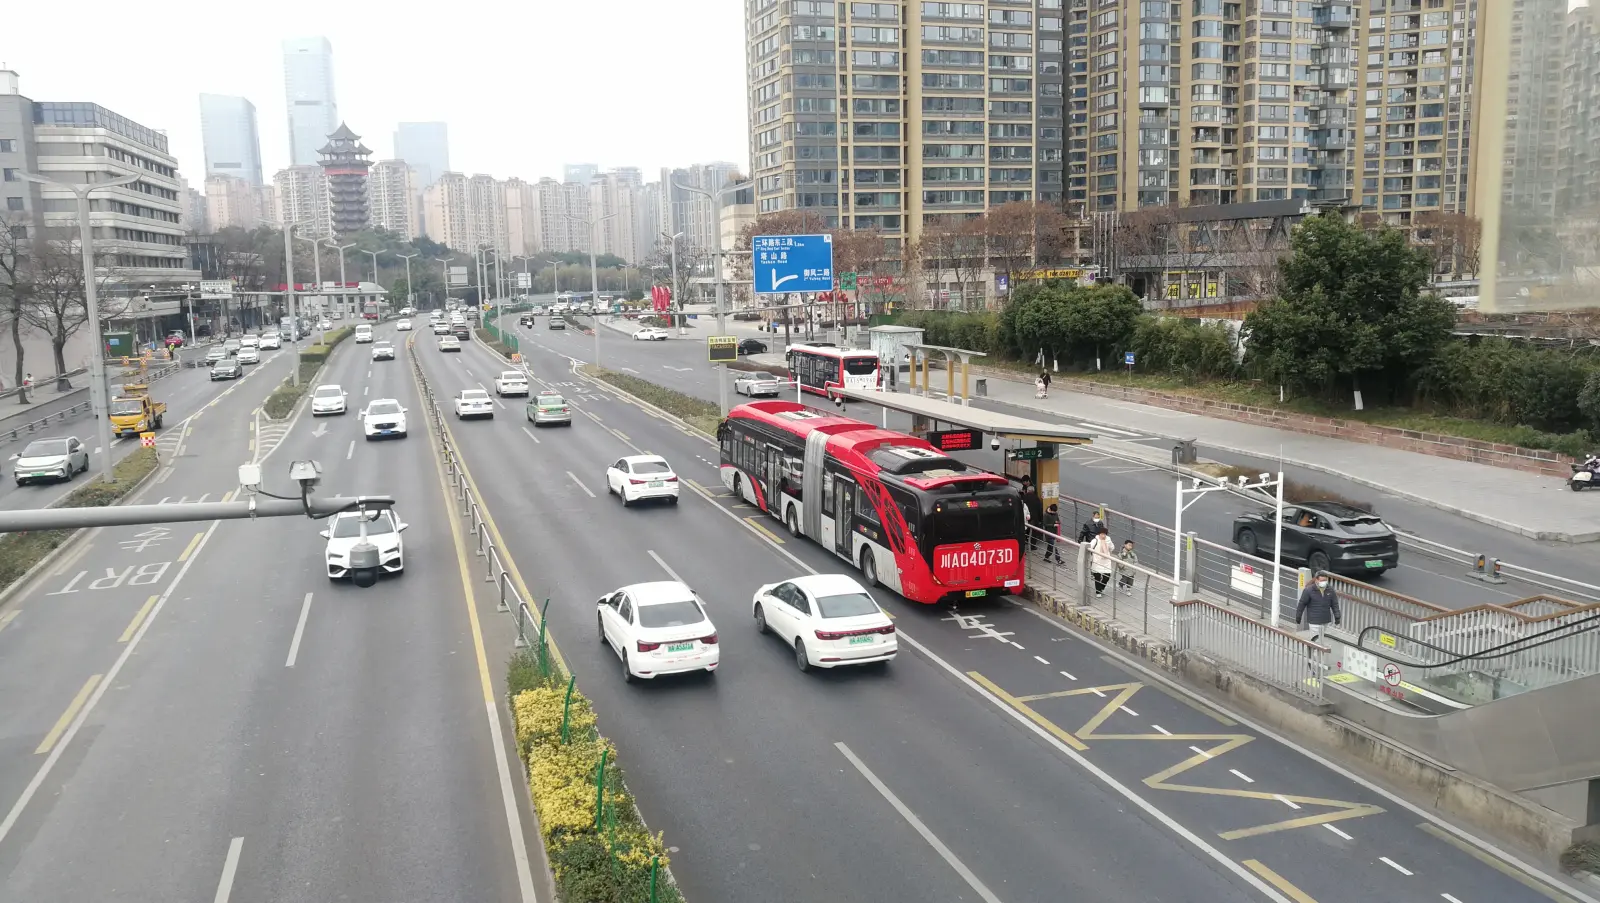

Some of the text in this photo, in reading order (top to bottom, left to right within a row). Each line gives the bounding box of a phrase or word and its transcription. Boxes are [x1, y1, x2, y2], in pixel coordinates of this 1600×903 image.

[1037, 449, 1043, 458] 2
[940, 548, 1013, 569] 川A04073D
[45, 561, 172, 596] BRT
